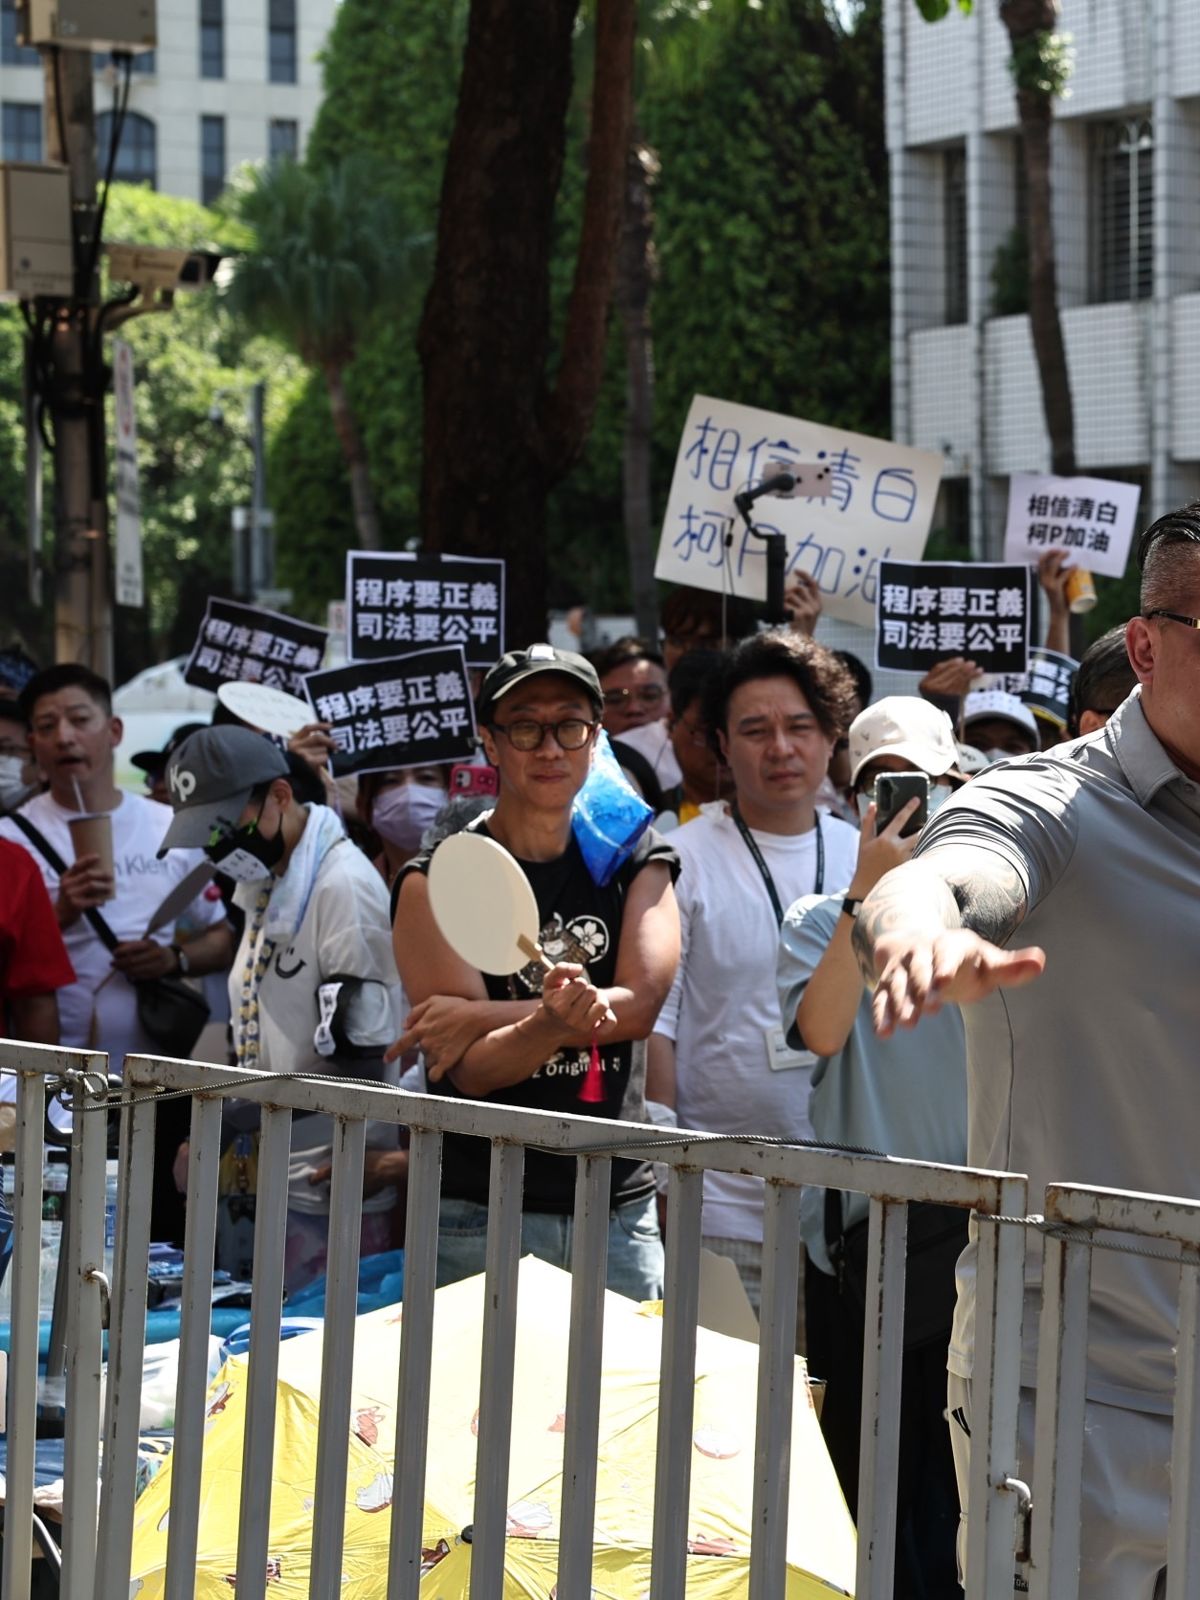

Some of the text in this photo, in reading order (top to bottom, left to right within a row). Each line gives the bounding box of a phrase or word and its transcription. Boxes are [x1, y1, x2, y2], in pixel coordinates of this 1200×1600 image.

[1029, 496, 1118, 525] 相信清白
[1027, 523, 1111, 553] 柯P加油
[355, 578, 498, 611] 程序要正義
[882, 584, 1024, 618] 程序要正義
[205, 618, 321, 671] 程序要正義
[356, 613, 498, 645] 司法要公平
[883, 619, 1023, 652] 司法要公平
[315, 671, 466, 723] 程序要正義
[329, 706, 469, 754] 司法要公平
[546, 1058, 606, 1077] Originl
